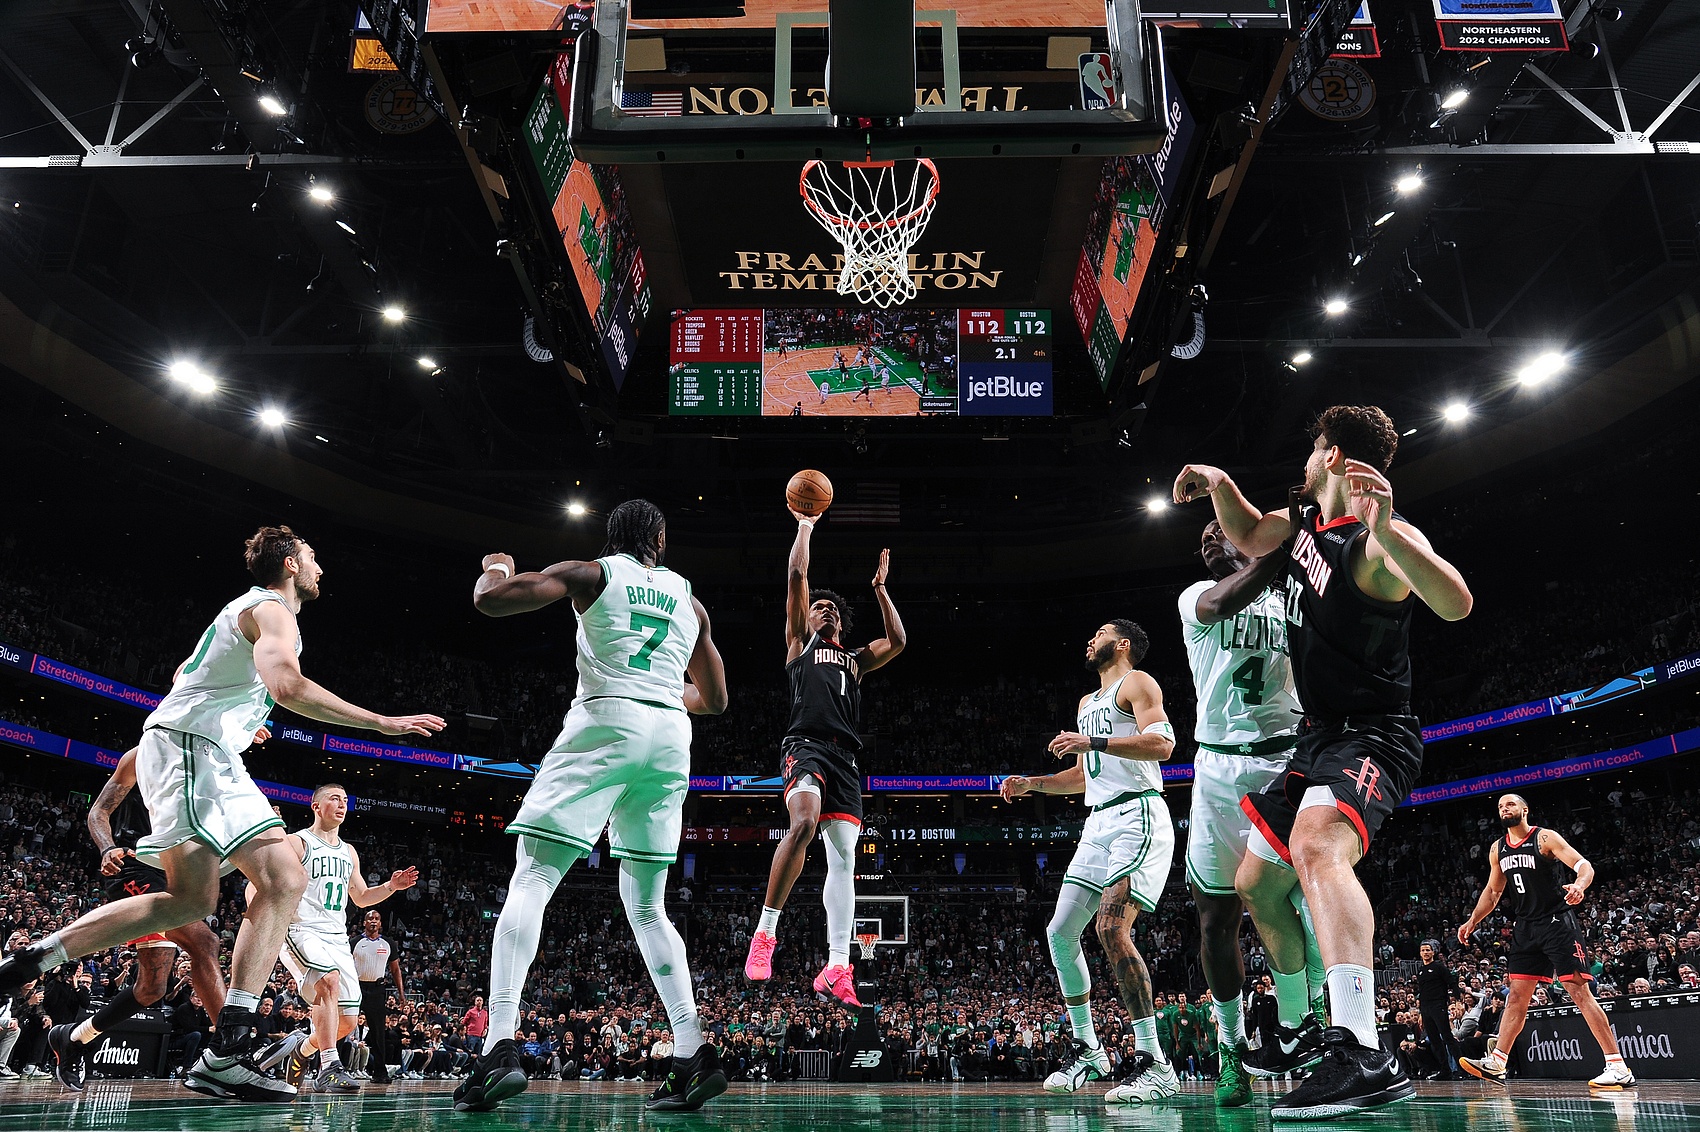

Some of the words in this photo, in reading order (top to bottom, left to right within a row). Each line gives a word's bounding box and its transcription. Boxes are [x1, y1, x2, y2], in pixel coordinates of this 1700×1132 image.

[1462, 26, 1541, 34] NORTHEASTERN
[1458, 36, 1485, 44] 2024
[1488, 36, 1551, 44] CHAMPIONS
[1315, 104, 1361, 117] 1926-1940
[378, 117, 426, 131] 1979-2000
[967, 320, 999, 334] 112
[1013, 320, 1046, 334] 112
[995, 347, 1016, 359] 2.1
[966, 375, 1045, 402] jetBlue
[625, 585, 678, 616] BROWN
[627, 611, 670, 672] 7
[38, 660, 95, 690] Stretching
[1666, 657, 1700, 679] jetBlue
[839, 670, 846, 696] 1
[1232, 655, 1265, 706] 4
[0, 727, 36, 745] coach.
[281, 727, 313, 743] jetBlue
[1421, 721, 1475, 740] Stretching
[328, 738, 383, 757] Stretching
[873, 778, 923, 789] Stretching
[1410, 789, 1449, 803] Stretch
[1449, 785, 1468, 795] out
[1469, 779, 1493, 792] with
[1493, 776, 1512, 787] the
[1513, 769, 1542, 783] most
[1543, 759, 1592, 779] legroom
[1593, 758, 1605, 768] in
[1606, 749, 1645, 766] coach.
[354, 804, 372, 812] LAST
[356, 797, 377, 806] THAT'S
[409, 804, 427, 812] FIRST
[434, 806, 446, 814] THE
[891, 829, 916, 840] 112
[921, 828, 956, 840] BOSTON
[1050, 830, 1069, 839] 39/79
[1513, 873, 1526, 894] 9
[323, 881, 343, 912] 11
[92, 1037, 140, 1065] Amica
[1527, 1029, 1584, 1063] Amica
